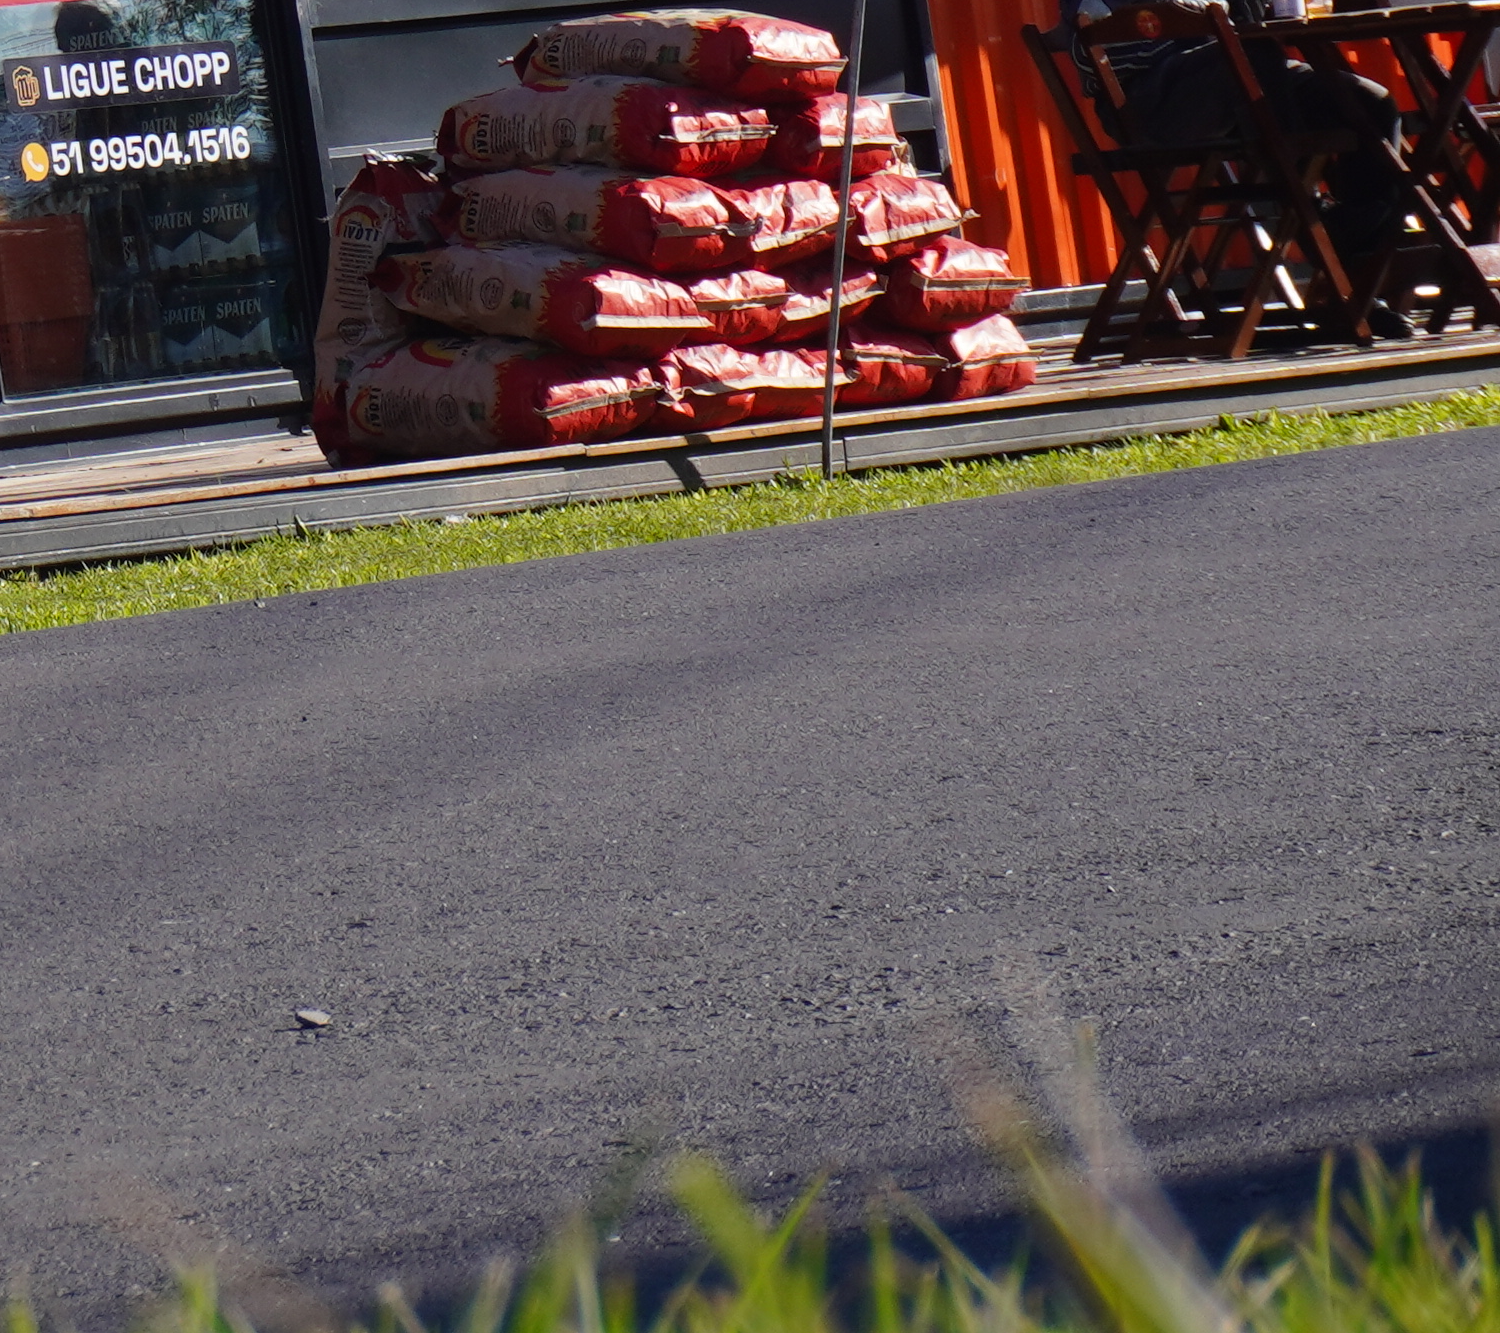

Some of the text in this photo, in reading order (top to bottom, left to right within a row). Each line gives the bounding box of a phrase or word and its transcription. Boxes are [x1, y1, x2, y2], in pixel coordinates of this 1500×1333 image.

[42, 50, 231, 101] LIGUE CHOPP
[50, 125, 251, 178] 51 99504.1516
[202, 202, 250, 225] SPATEN
[216, 297, 262, 320] SPATEN
